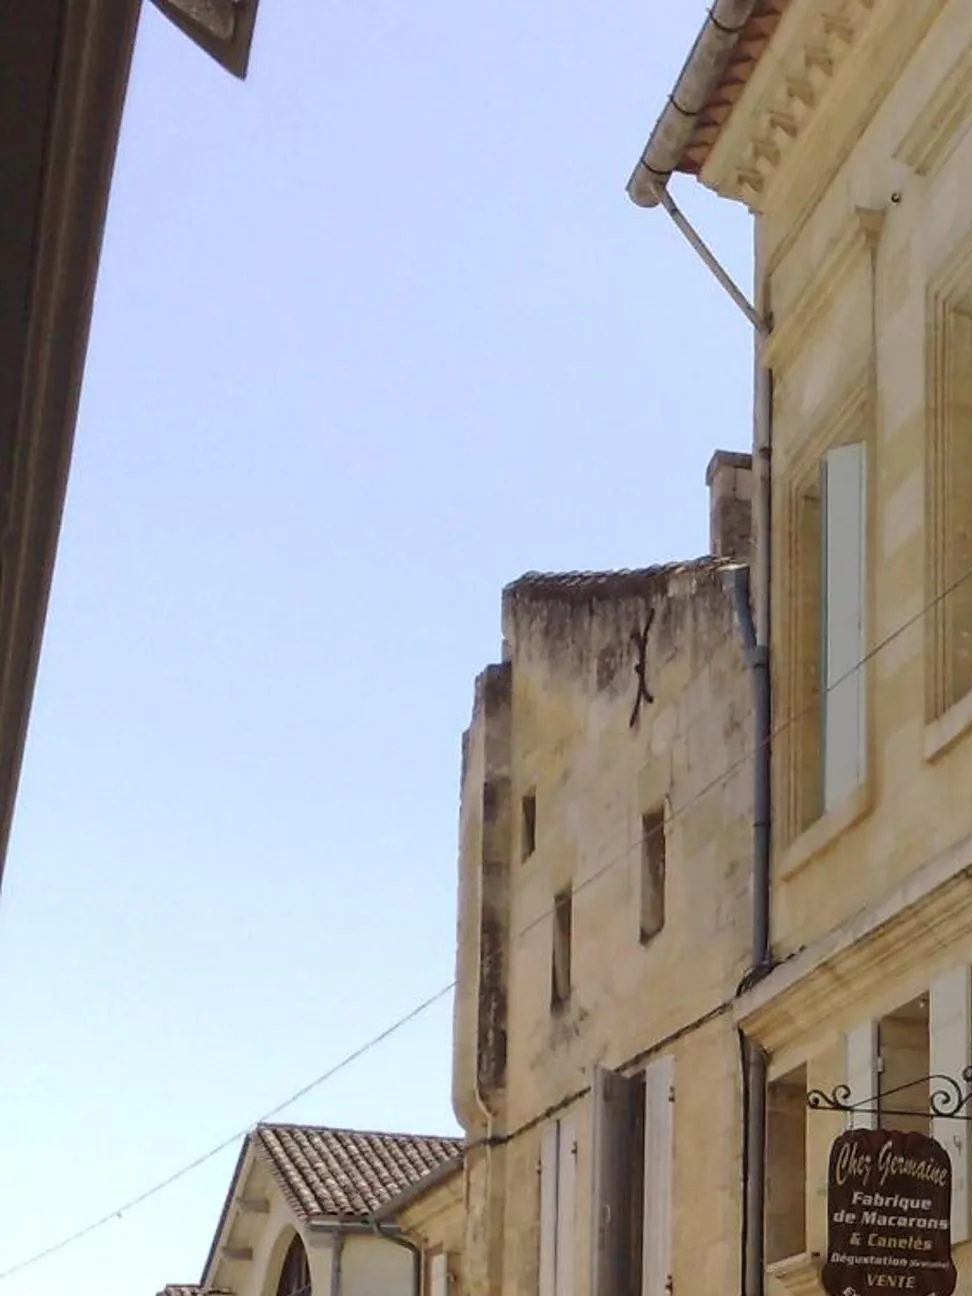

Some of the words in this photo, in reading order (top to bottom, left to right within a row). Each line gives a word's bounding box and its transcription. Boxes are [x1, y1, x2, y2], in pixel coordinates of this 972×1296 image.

[836, 1141, 872, 1187] Chez
[878, 1139, 949, 1187] Germaine
[851, 1191, 932, 1212] Fabrique
[833, 1210, 857, 1224] de
[861, 1211, 949, 1230] Macarons
[850, 1232, 862, 1245] &
[831, 1252, 908, 1267] Dégustation
[867, 1273, 917, 1289] VENTE
